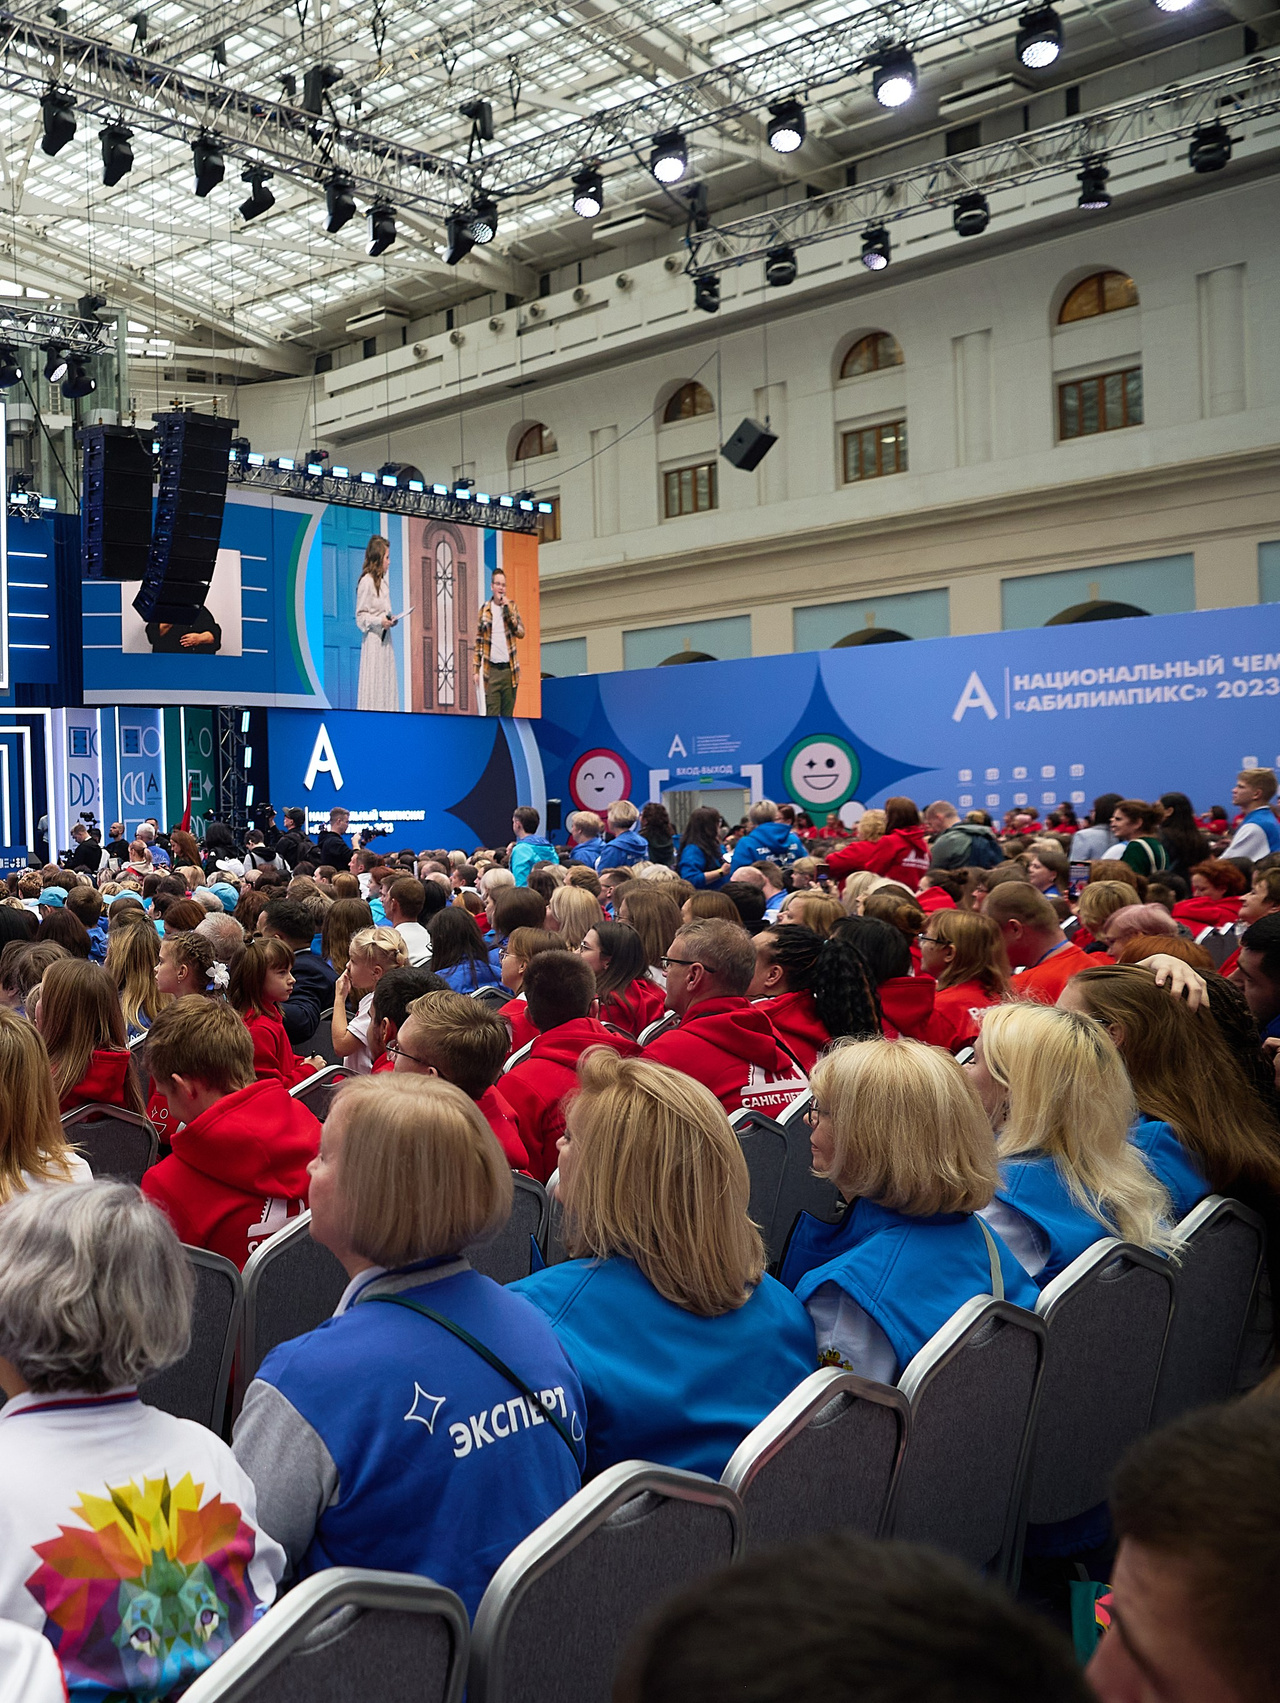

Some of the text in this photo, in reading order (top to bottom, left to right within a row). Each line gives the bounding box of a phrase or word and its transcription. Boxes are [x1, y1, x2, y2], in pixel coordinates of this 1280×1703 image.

[1013, 654, 1225, 691] НАЦИОНАЛЬНЫЙ
[1013, 677, 1280, 712] «АБИЛИМПИКС» 2023
[448, 1386, 568, 1458] ЭКСПЕРТ
